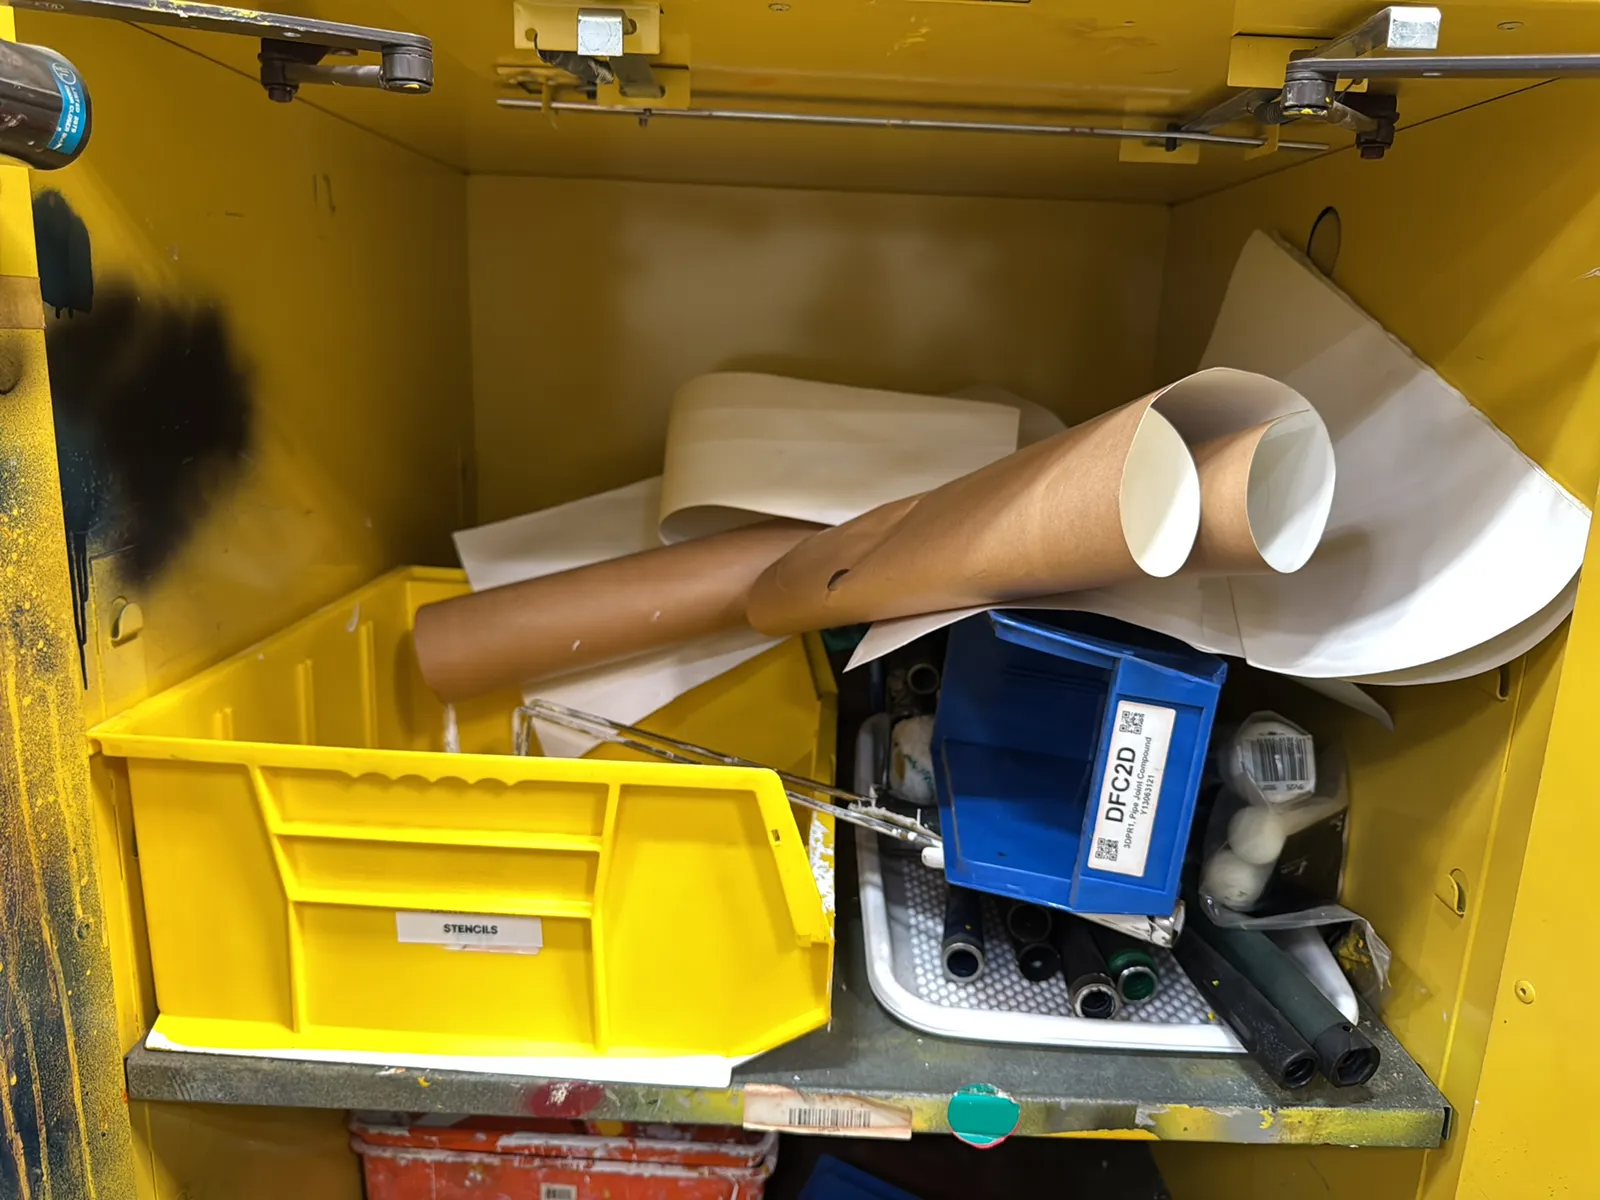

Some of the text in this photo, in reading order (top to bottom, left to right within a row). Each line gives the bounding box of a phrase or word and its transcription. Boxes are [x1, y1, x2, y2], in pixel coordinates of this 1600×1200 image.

[1105, 746, 1136, 823] DFC2D
[1123, 737, 1152, 849] 3DPR1, Pipe Joint Compound
[1139, 775, 1156, 816] Y13063121
[443, 924, 498, 935] STENCILS
